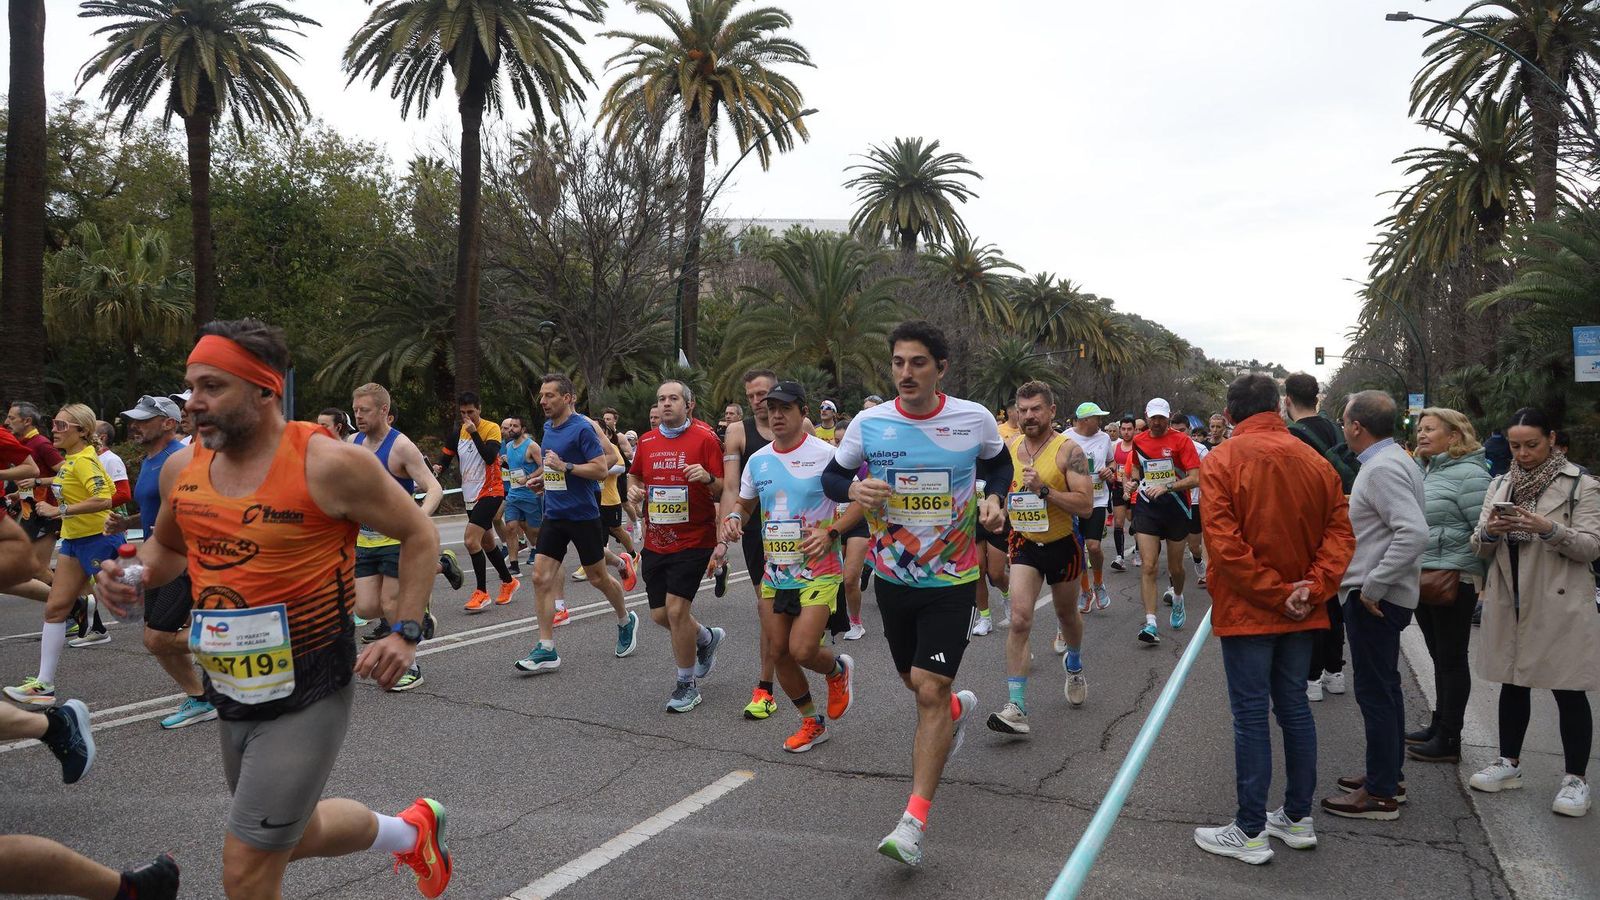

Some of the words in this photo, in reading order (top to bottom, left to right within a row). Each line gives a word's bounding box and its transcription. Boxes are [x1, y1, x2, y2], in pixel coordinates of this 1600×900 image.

[653, 460, 676, 470] MÁLAGA
[545, 473, 560, 482] 2633
[1151, 472, 1170, 480] 2320
[902, 496, 942, 510] 1366
[656, 504, 682, 513] 1262
[1016, 511, 1040, 521] 2135
[769, 541, 796, 553] 1362
[212, 653, 274, 678] 3719
